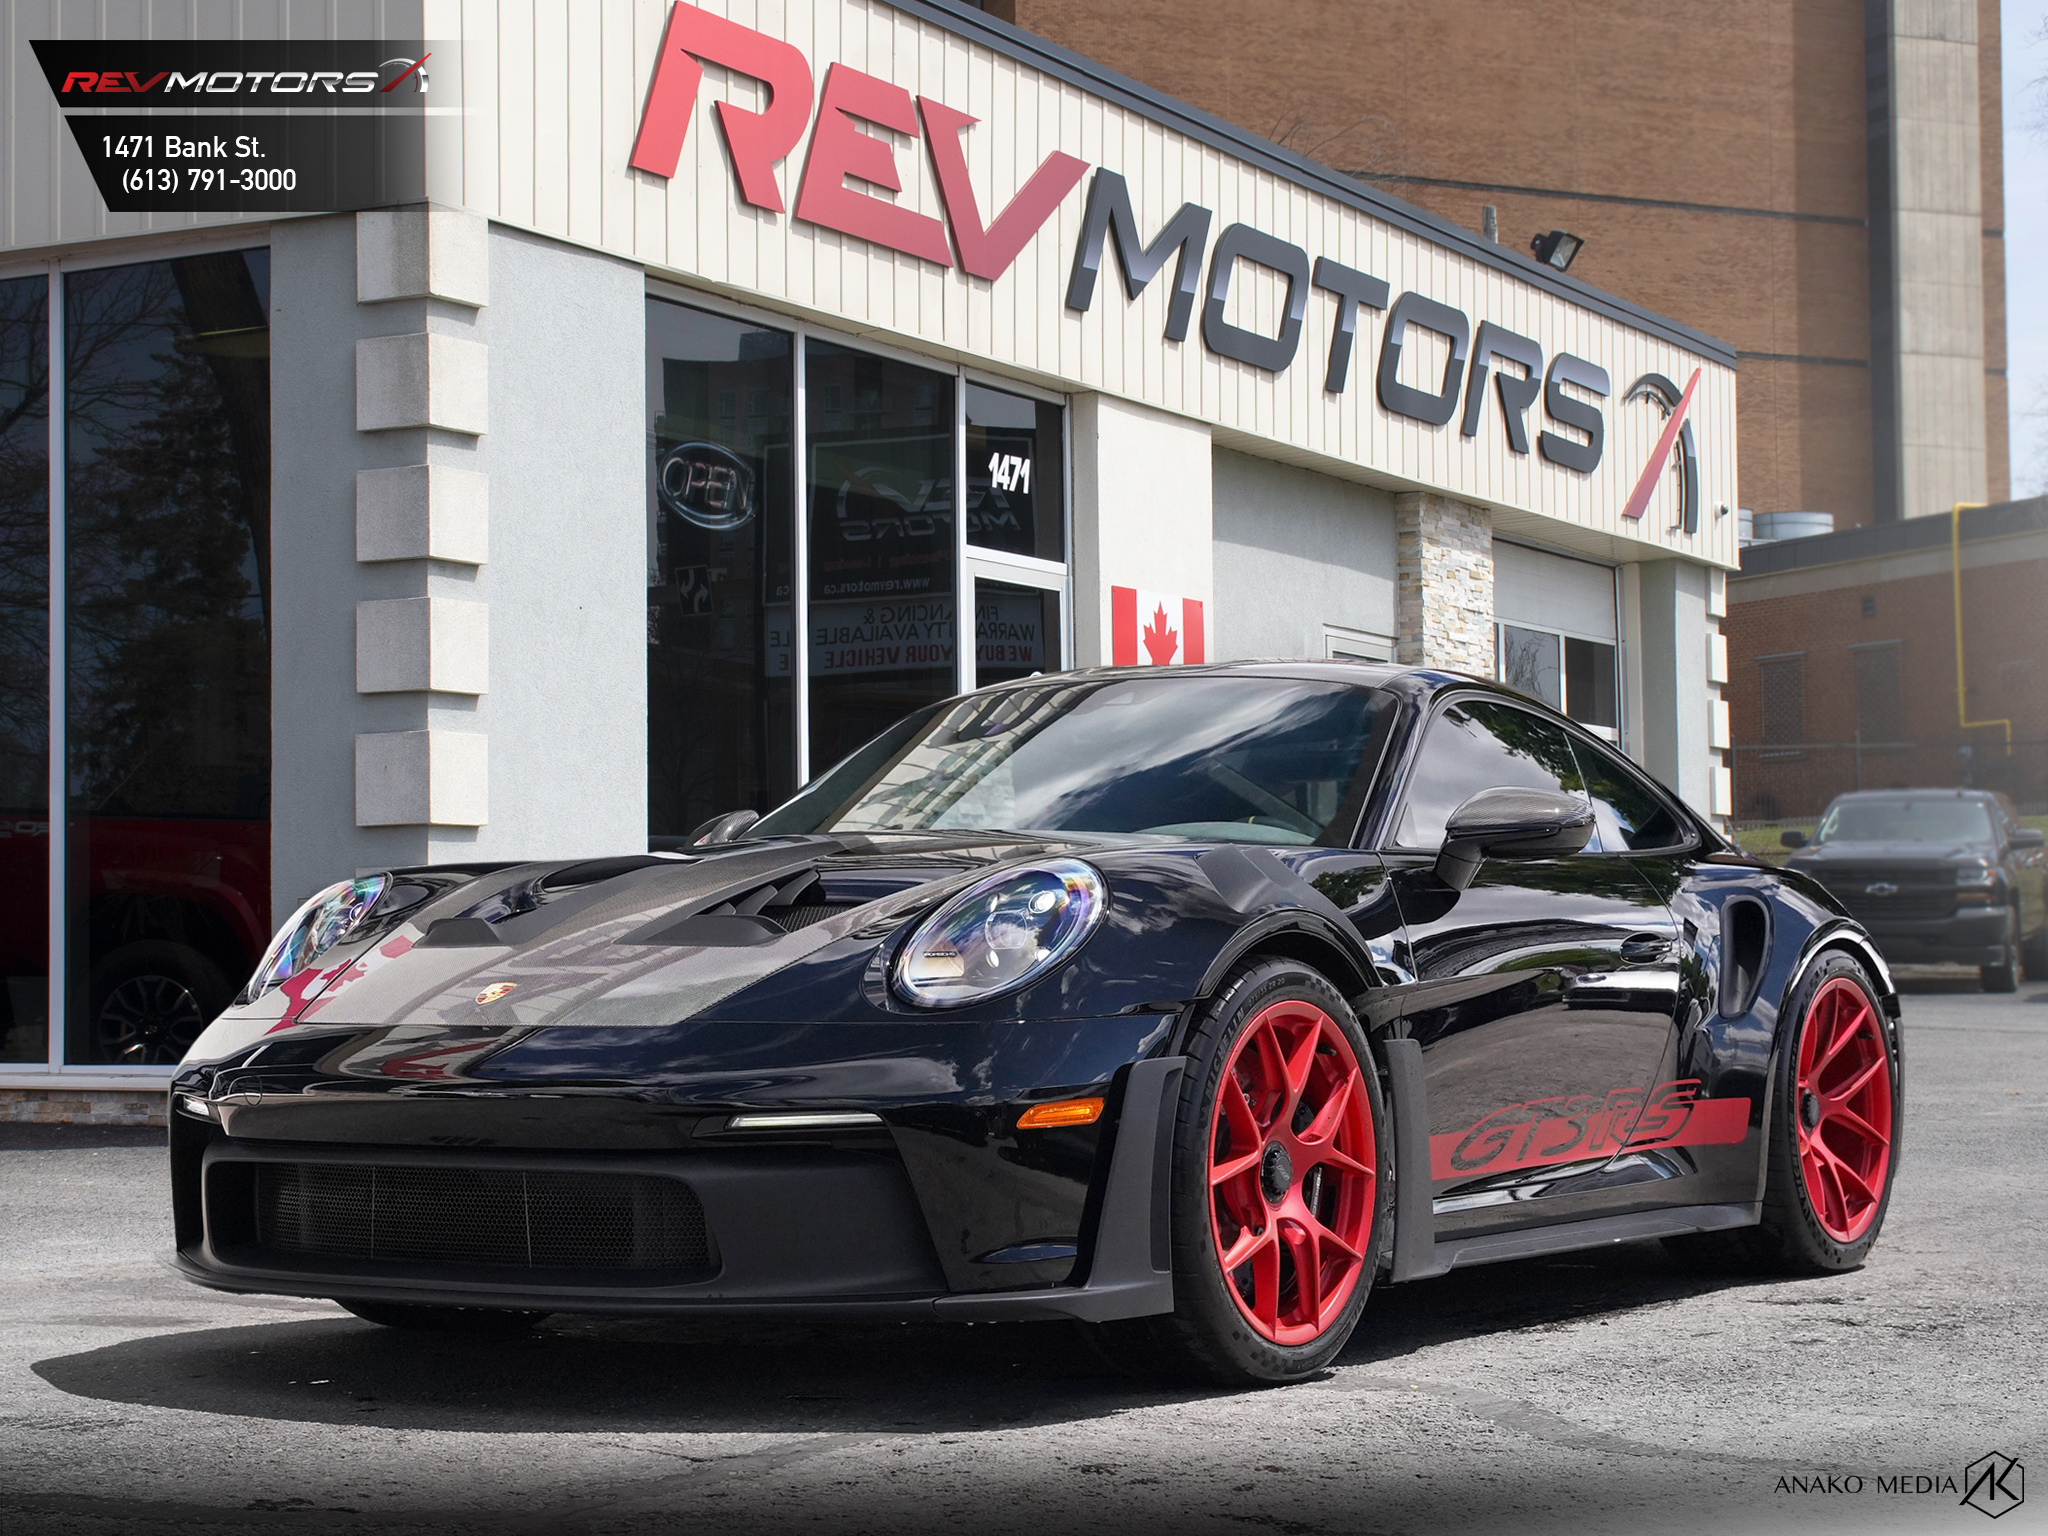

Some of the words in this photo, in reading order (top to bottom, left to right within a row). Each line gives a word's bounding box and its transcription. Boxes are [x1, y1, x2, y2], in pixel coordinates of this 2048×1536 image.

[662, 456, 749, 512] OPEN
[988, 452, 1031, 494] 1471
[1205, 1008, 1246, 1100] MICHELIN
